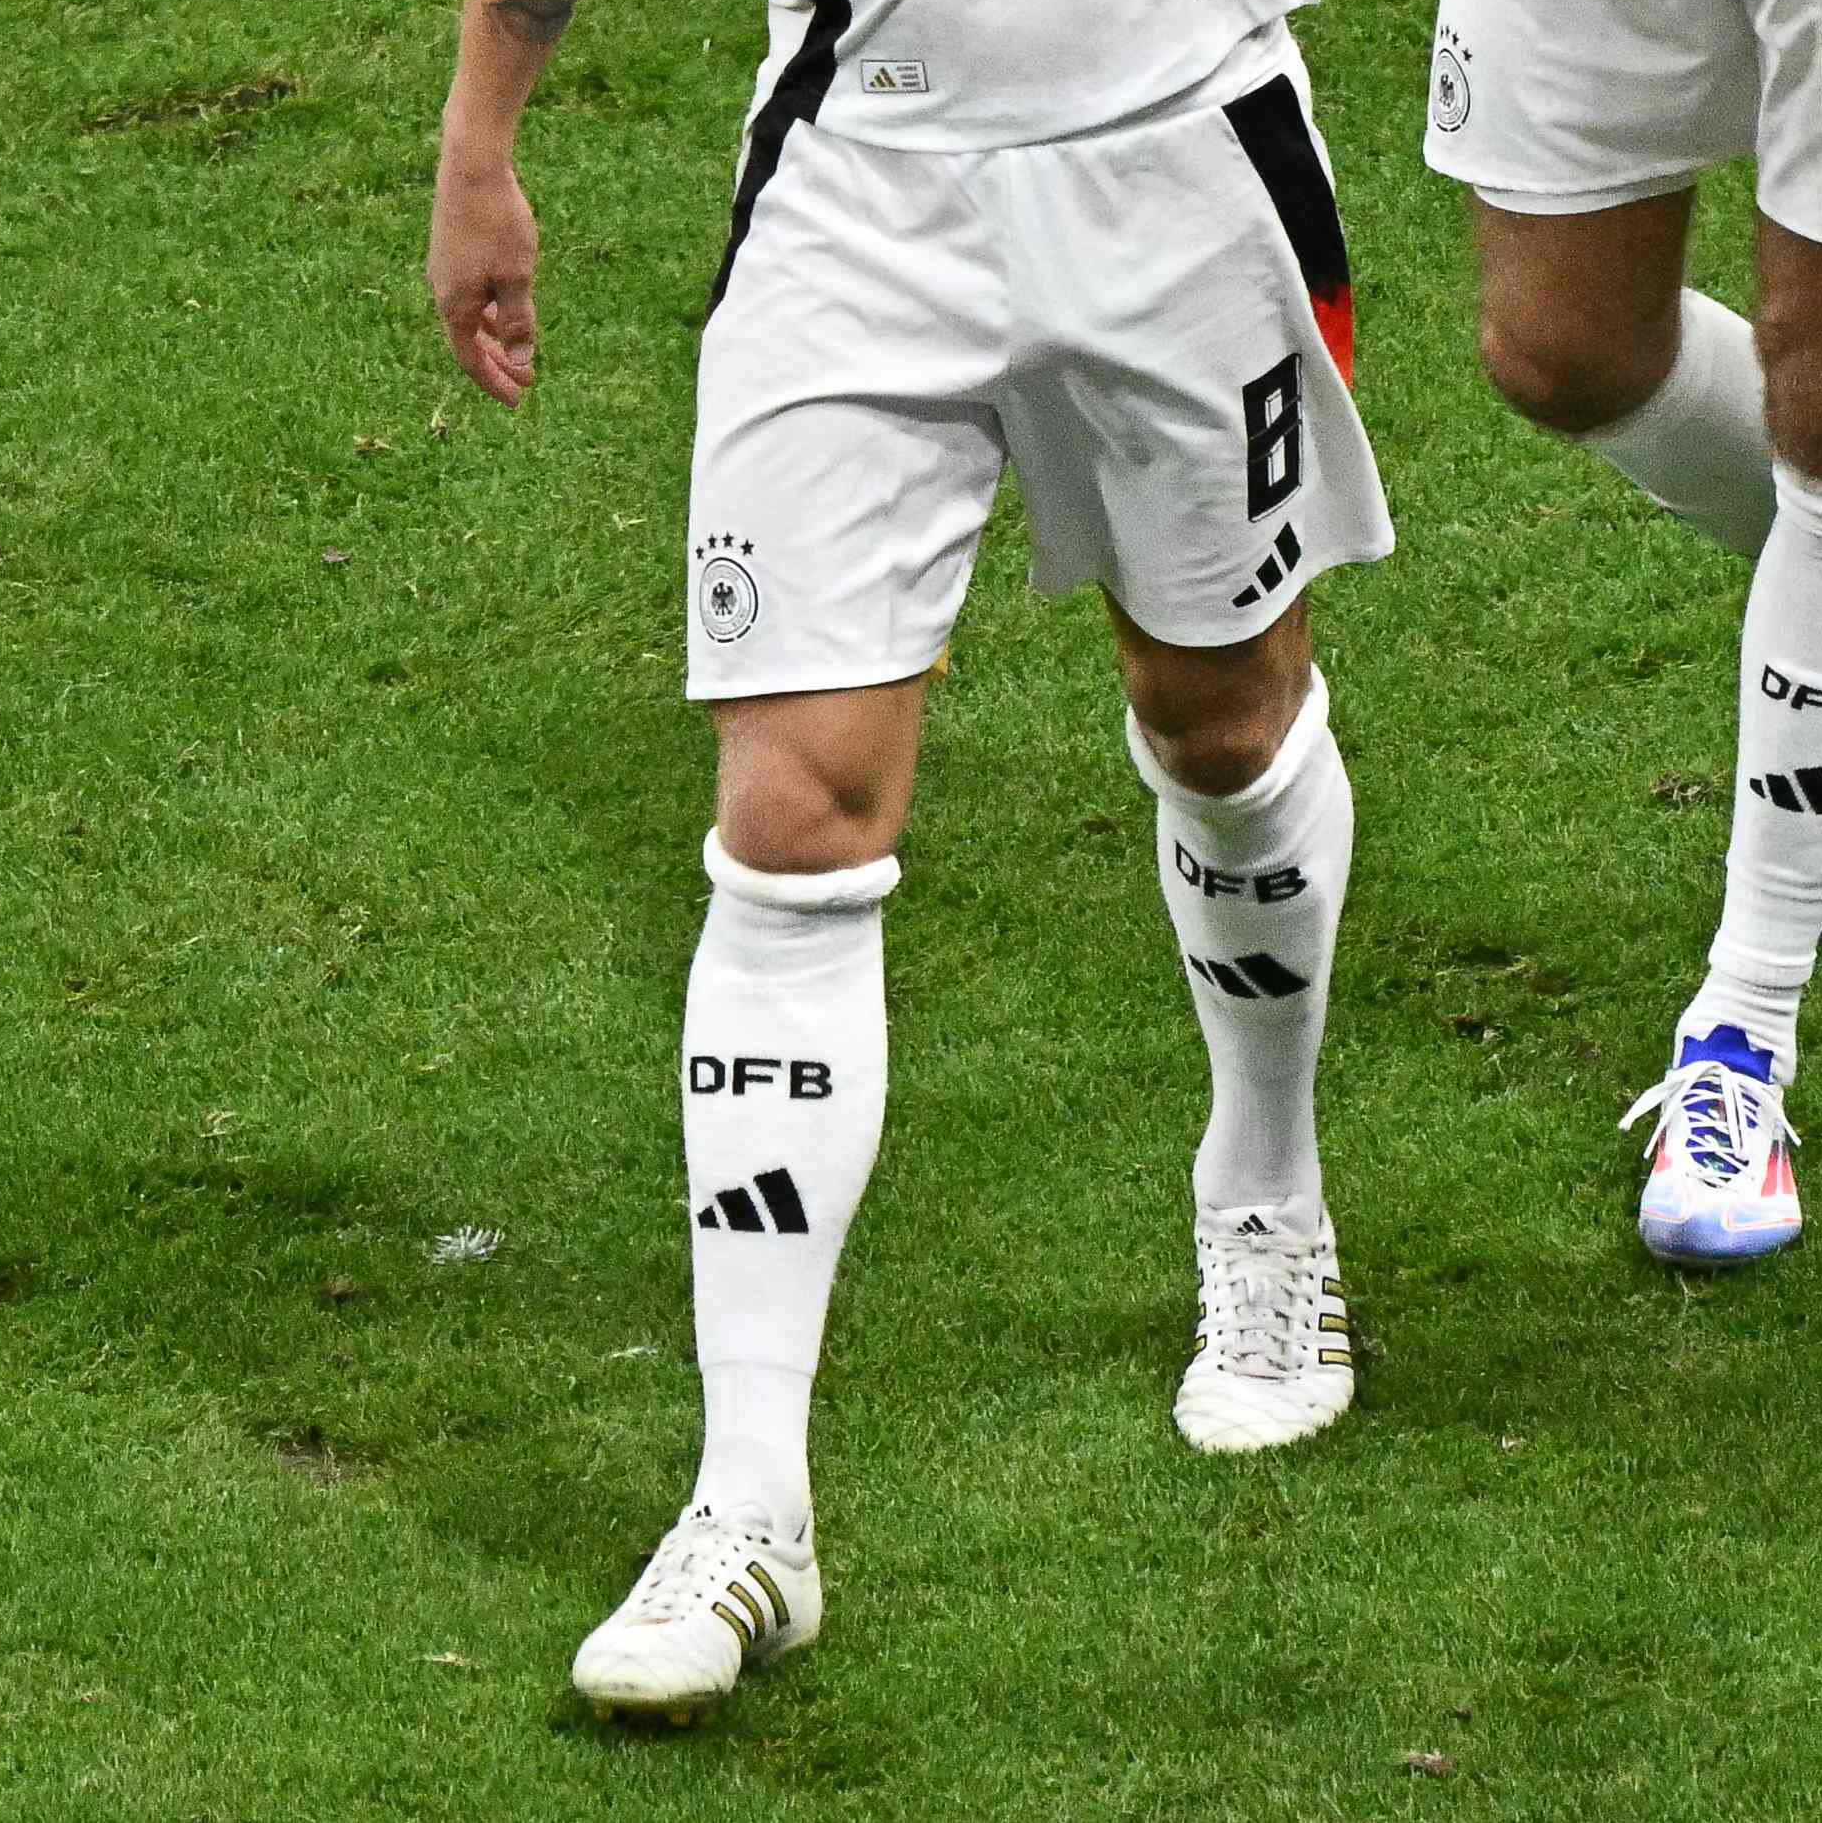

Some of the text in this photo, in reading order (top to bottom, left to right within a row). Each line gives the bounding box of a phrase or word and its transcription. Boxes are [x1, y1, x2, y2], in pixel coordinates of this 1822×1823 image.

[1241, 352, 1303, 524] 8
[1174, 838, 1308, 905] DFB
[689, 1054, 834, 1100] DFB
